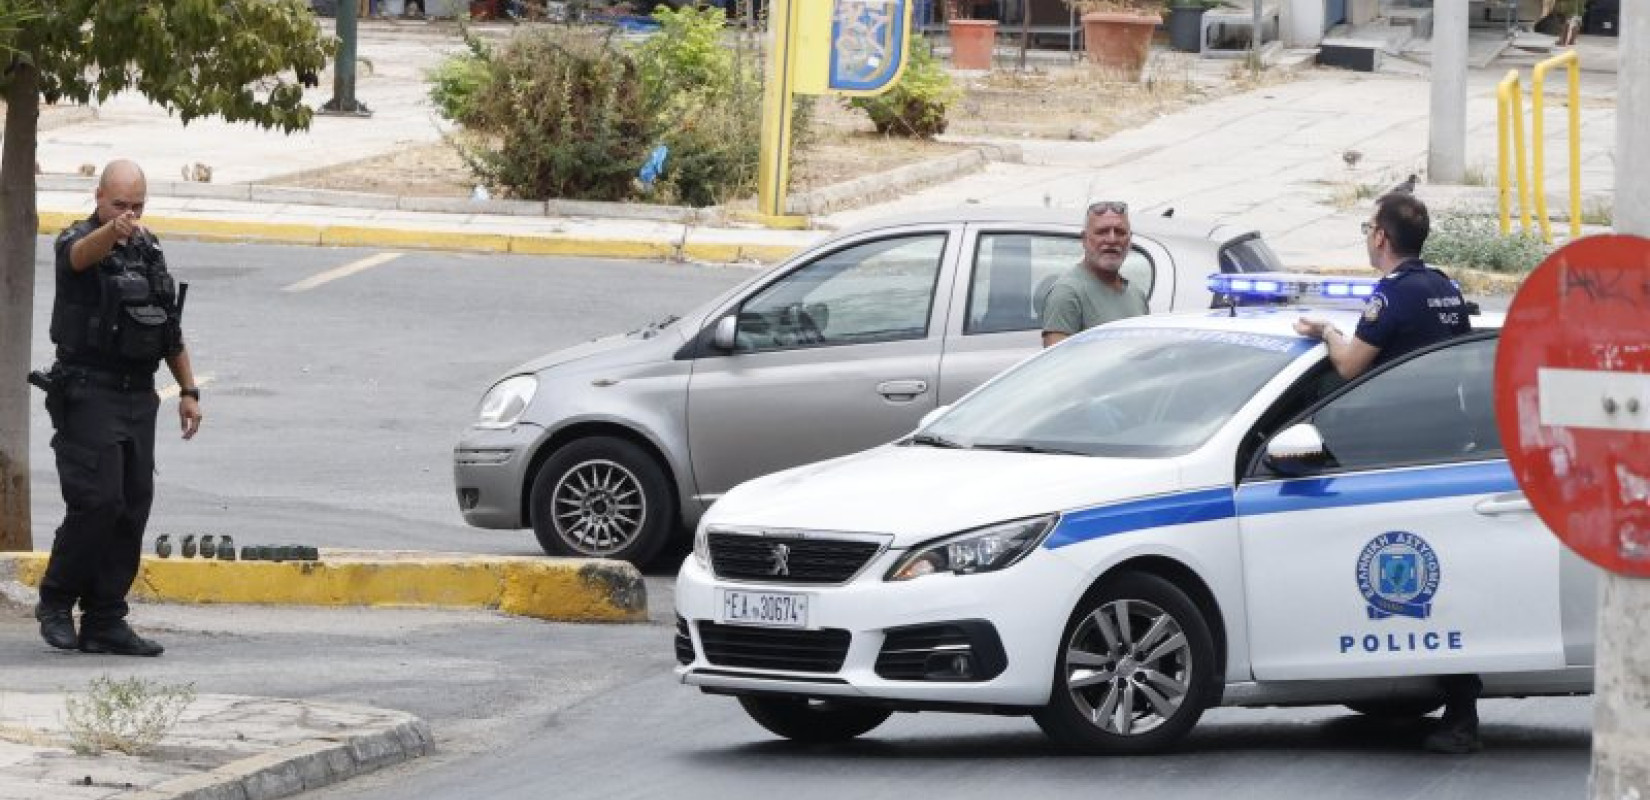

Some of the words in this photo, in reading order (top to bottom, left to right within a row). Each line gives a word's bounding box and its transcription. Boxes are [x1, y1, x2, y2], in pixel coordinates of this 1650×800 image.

[1358, 533, 1389, 598] ΕΛΛΗΝΙΚΗ
[1395, 532, 1439, 595] ΑΣΤΥΝΟΜΙΑ
[760, 595, 798, 622] 30674
[1339, 631, 1463, 653] POLICE
